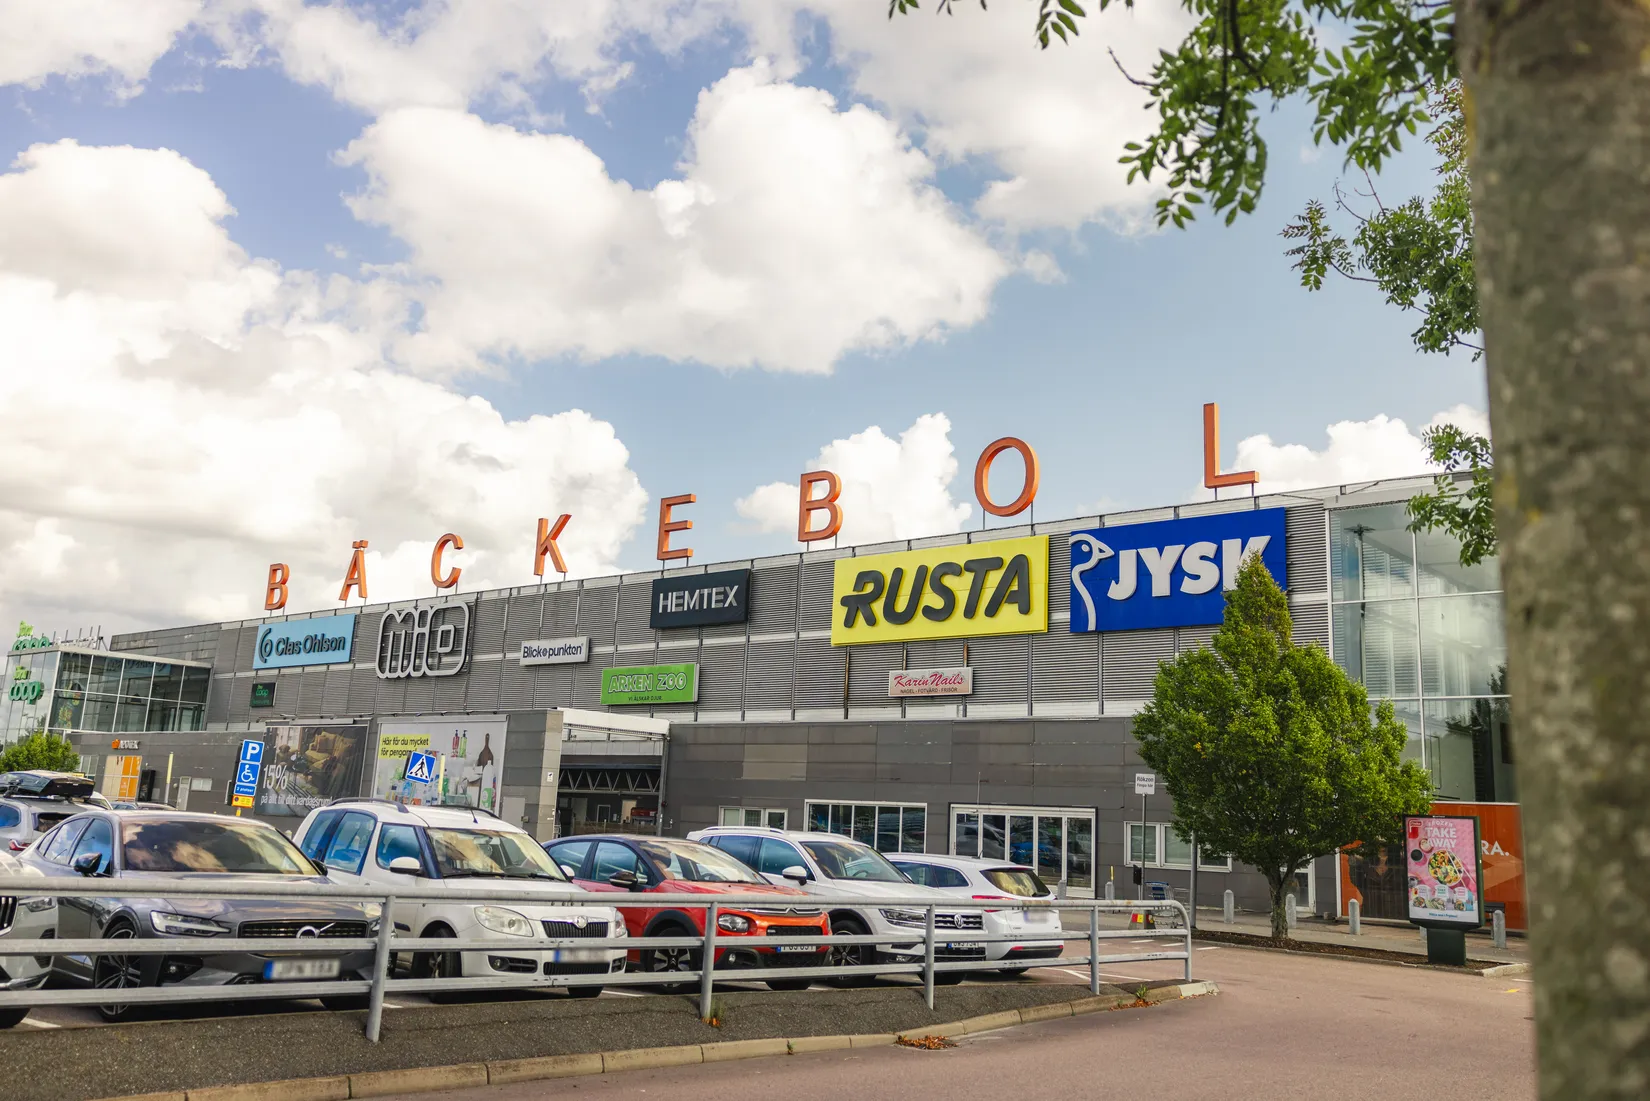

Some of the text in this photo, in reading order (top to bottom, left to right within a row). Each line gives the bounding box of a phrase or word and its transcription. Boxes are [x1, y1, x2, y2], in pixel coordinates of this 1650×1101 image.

[1108, 535, 1271, 601] JYSK
[659, 585, 738, 613] HEMTEX
[841, 553, 1030, 629] RUSTA
[275, 633, 346, 656] Clas Ohlson
[608, 672, 687, 693] ARKEN ZOO
[894, 673, 964, 687] Karin Nails
[8, 681, 42, 705] coop
[246, 743, 260, 760] P
[401, 737, 408, 746] du
[409, 737, 429, 748] mycket
[263, 764, 288, 790] 15%
[260, 793, 268, 805] på
[1426, 828, 1456, 838] TAKE
[1427, 838, 1456, 848] AWAY
